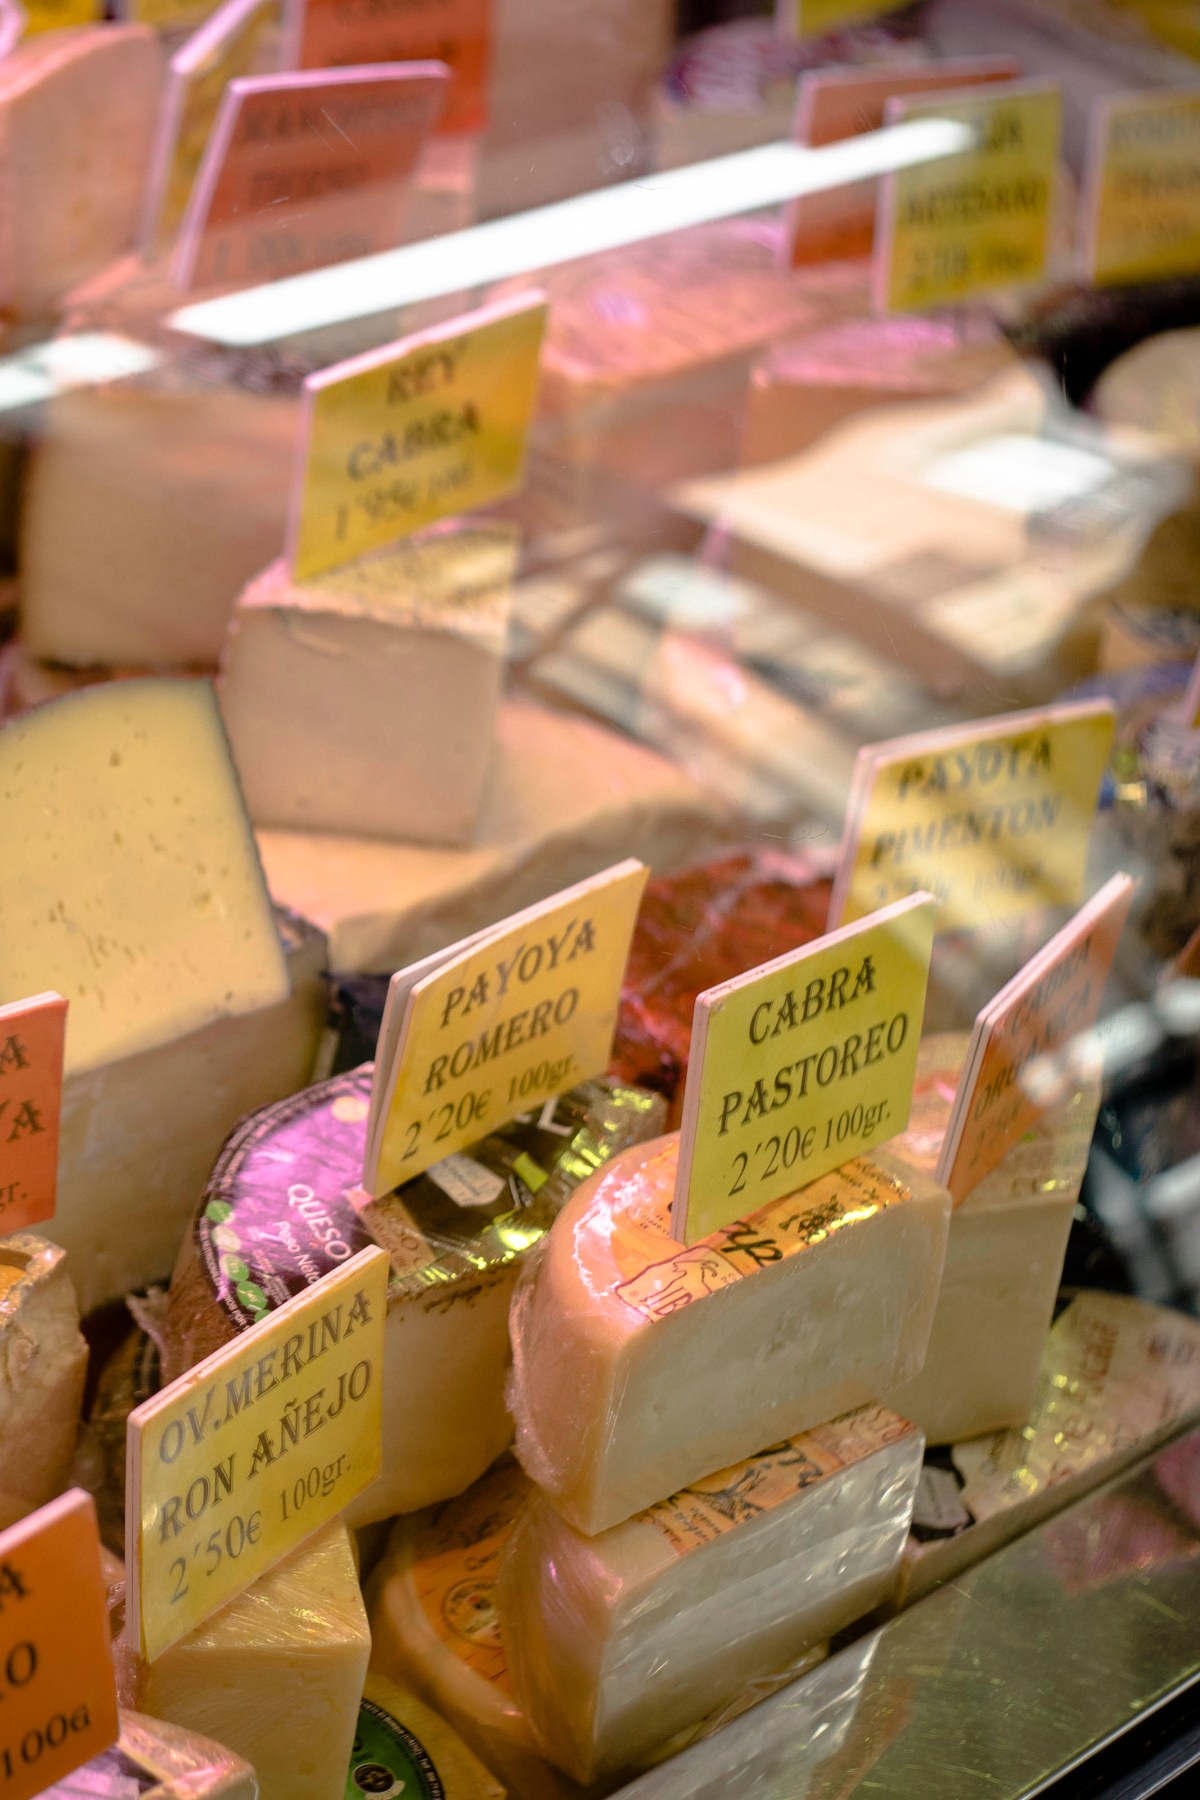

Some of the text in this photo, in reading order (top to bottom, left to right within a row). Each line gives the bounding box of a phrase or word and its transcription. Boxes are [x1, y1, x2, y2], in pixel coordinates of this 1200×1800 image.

[346, 402, 481, 482] CABRA
[897, 736, 1053, 800] PAYOYA
[438, 918, 597, 1030] PAYOYA
[748, 955, 877, 1046] CABRA
[422, 987, 580, 1097] ROMERO
[717, 1012, 909, 1137] PASTOREO
[400, 1088, 493, 1162] 2'20€
[507, 1054, 579, 1104] 100gr.
[727, 1126, 817, 1197] 2'20€
[823, 1099, 891, 1151] 100gr.
[273, 1220, 300, 1254] Peso
[288, 1183, 351, 1261] QUESO
[158, 1287, 374, 1465] OV.MERINA
[159, 1359, 373, 1547] RON AÑEJO
[168, 1453, 353, 1604] 2'50€ 100gr.
